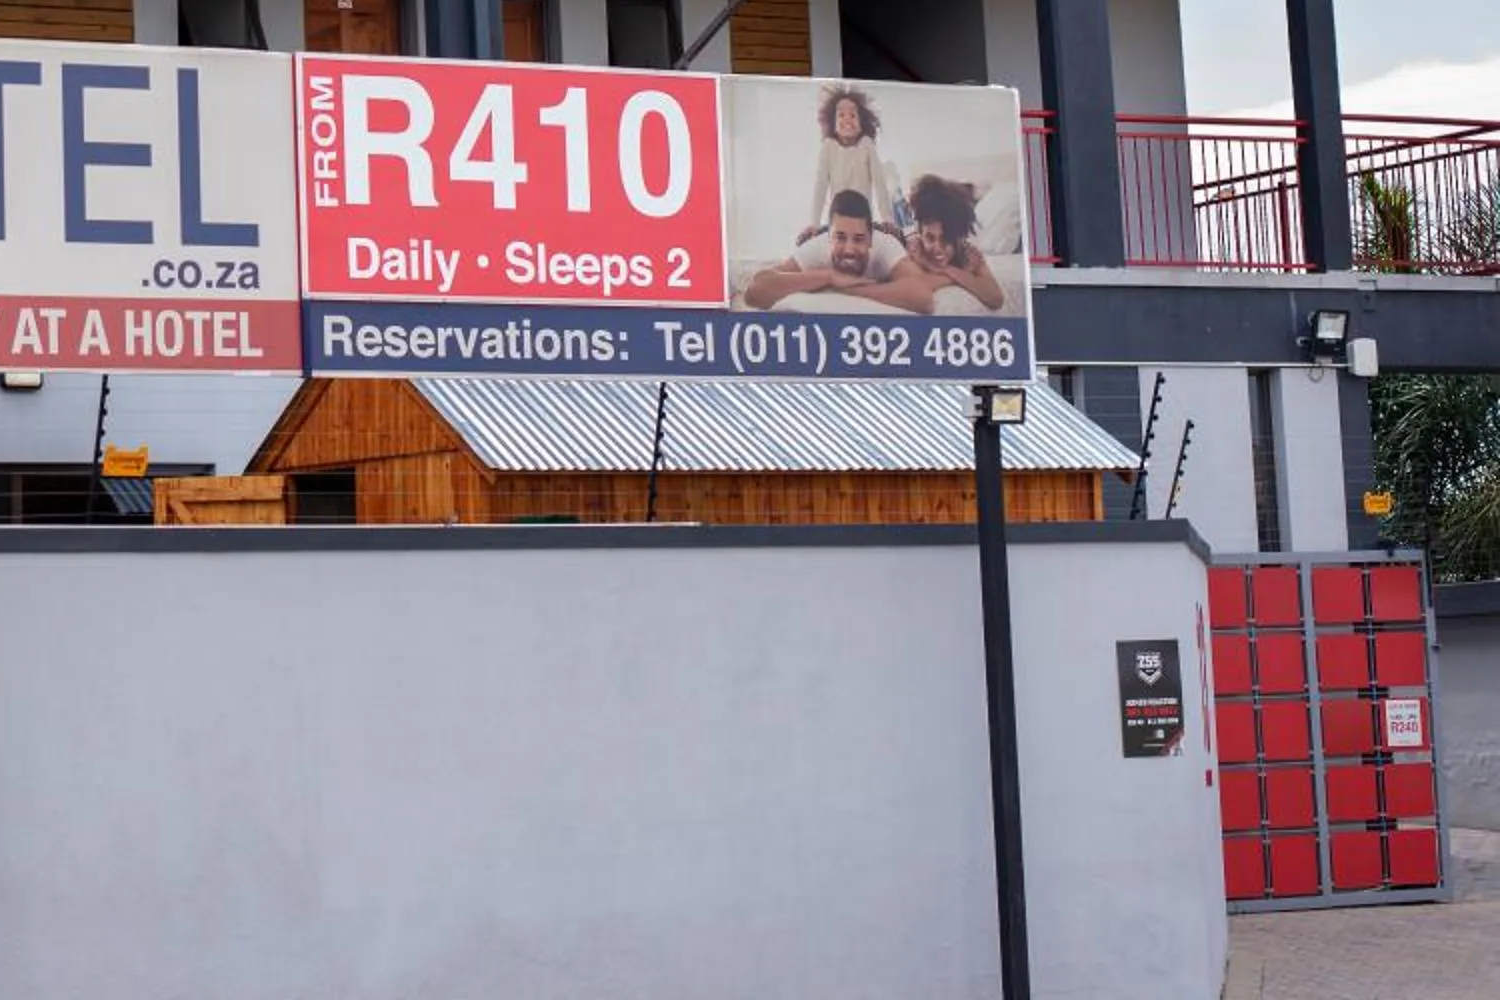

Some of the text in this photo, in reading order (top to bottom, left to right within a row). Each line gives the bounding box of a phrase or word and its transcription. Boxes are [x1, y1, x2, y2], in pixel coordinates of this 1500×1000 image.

[308, 75, 339, 208] FROM
[341, 73, 693, 218] R410
[140, 259, 261, 290] .co.za
[347, 236, 692, 297] Daily Sleeps 2
[11, 306, 67, 355] AT
[79, 309, 111, 357] A
[124, 310, 264, 358] HOTEL
[321, 314, 1016, 374] Reservations: Tel (011) 392 4886
